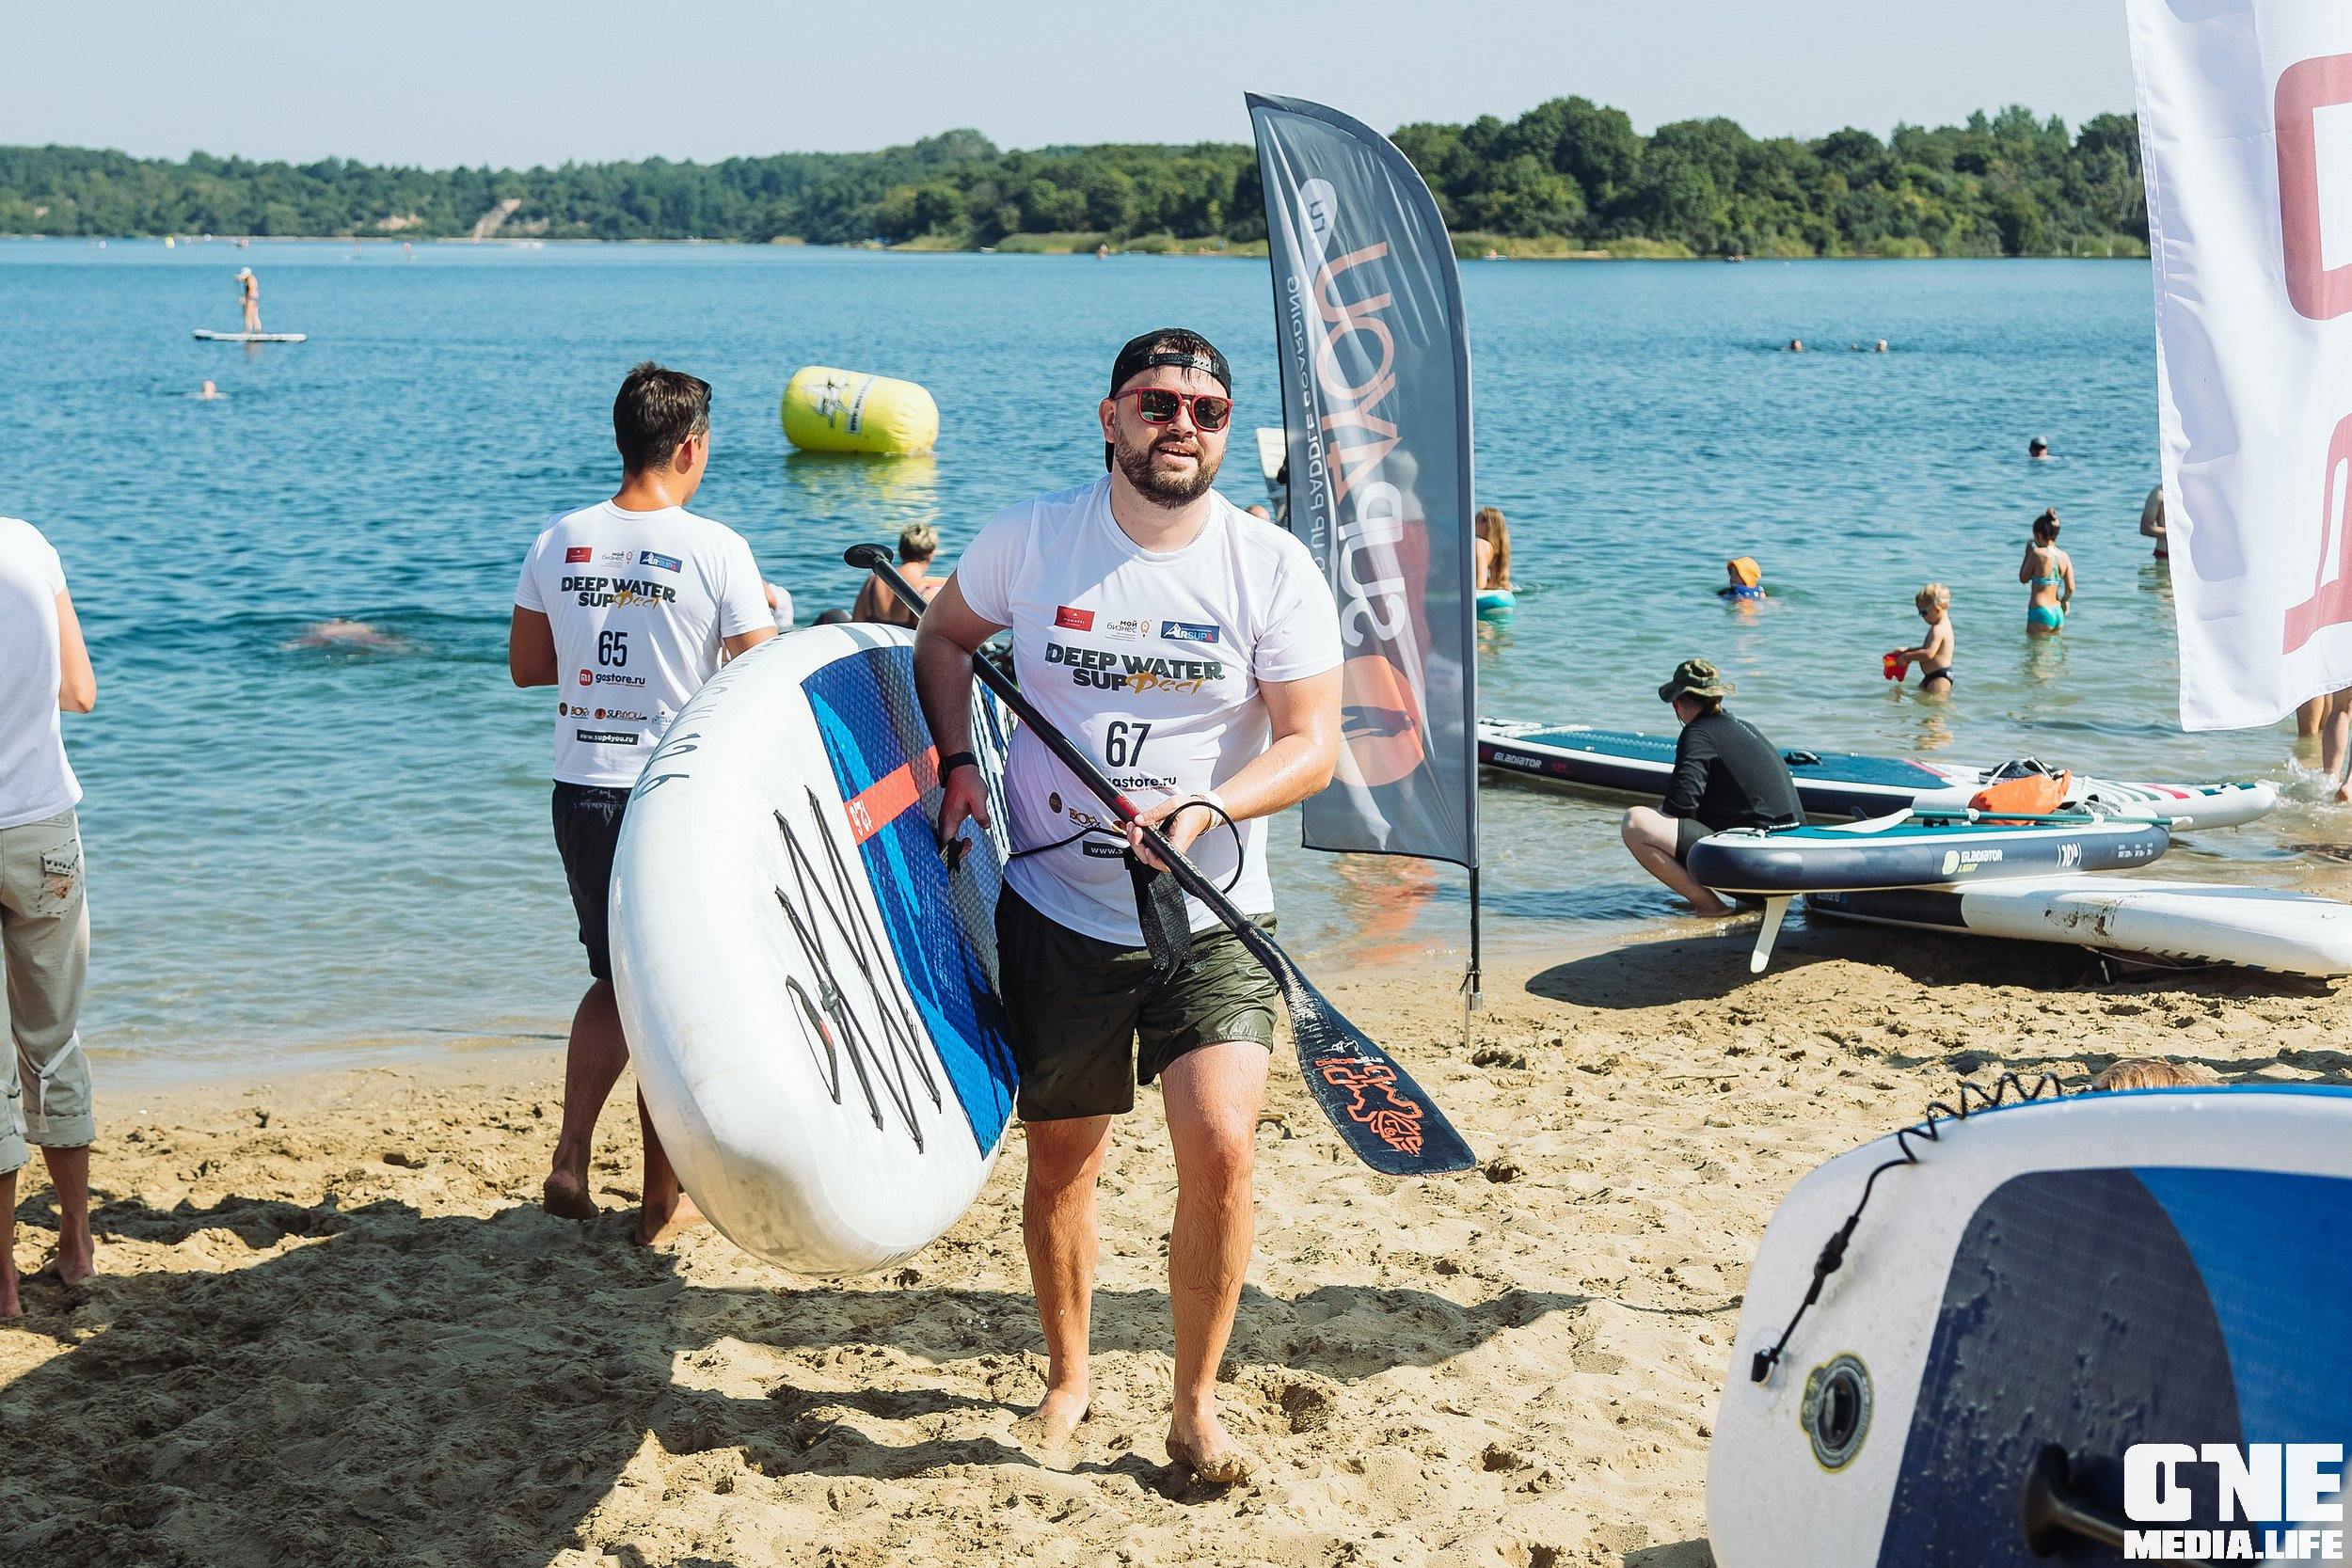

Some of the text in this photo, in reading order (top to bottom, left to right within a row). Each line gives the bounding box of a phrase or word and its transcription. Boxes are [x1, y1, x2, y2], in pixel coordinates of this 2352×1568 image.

[561, 576, 676, 603] DEEP WATER
[578, 592, 614, 608] SUP
[1106, 622, 1137, 633] бизнес
[597, 630, 628, 667] 65
[1044, 641, 1226, 681] DEEP WATER
[596, 673, 645, 685] gastore.ru
[1073, 668, 1128, 691] SUP
[1105, 721, 1152, 768] 67
[1493, 752, 1543, 768] GLADIATOR
[1108, 775, 1177, 788] astore.ru
[1961, 848, 2003, 863] GLADIATOR
